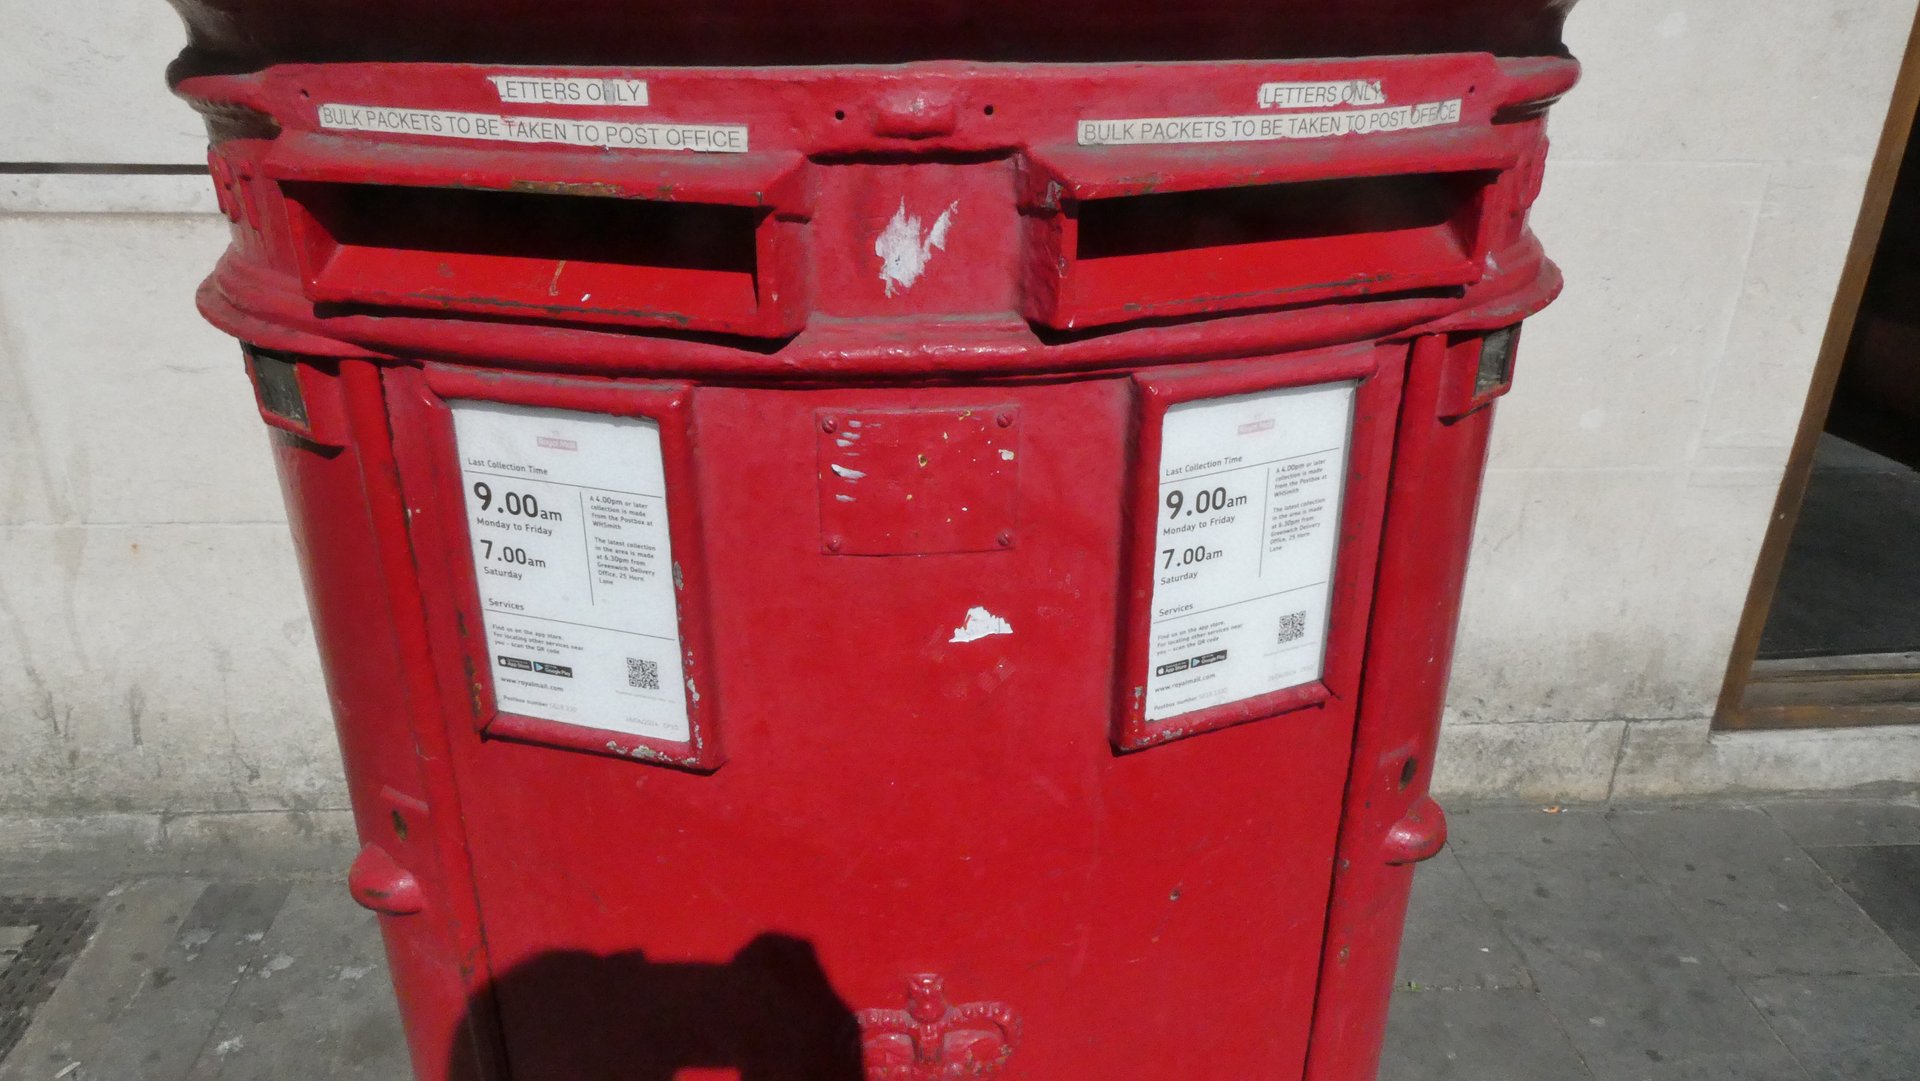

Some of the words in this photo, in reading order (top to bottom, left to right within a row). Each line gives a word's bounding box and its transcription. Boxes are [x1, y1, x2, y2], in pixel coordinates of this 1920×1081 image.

[1263, 86, 1337, 105] LETTERS
[322, 107, 362, 126] BULK
[366, 110, 442, 132] PACKETS
[446, 116, 471, 134] TO
[477, 119, 500, 136] BE
[504, 120, 567, 140] TAKEN
[572, 124, 600, 142] TO
[606, 126, 659, 145] POST
[666, 129, 740, 148] OFFICE
[1084, 123, 1136, 142] BULK
[1141, 121, 1226, 140] PACKETS
[1232, 120, 1255, 137] TO
[1260, 119, 1283, 136] BE
[1289, 116, 1341, 135] TAKEN
[1346, 114, 1366, 131] TO
[1370, 111, 1407, 129] POST
[467, 457, 485, 467] Last
[487, 459, 526, 472] Collection
[529, 465, 548, 475] Time
[1165, 466, 1182, 476] Last
[1185, 459, 1222, 473] Collection
[1223, 455, 1243, 465] Time
[473, 481, 562, 521] 9.00am
[1166, 487, 1247, 520] 9.00am
[476, 517, 510, 530] Monday
[513, 522, 522, 531] to
[525, 523, 553, 536] Friday
[1162, 523, 1196, 536] Monday
[1199, 521, 1207, 529] to
[1210, 515, 1236, 526] Friday
[480, 539, 546, 568] 7.00am
[594, 536, 606, 544] The
[607, 538, 625, 546] latest
[626, 542, 656, 551] collection
[1162, 545, 1223, 570] 7.00am
[483, 566, 522, 580] Saturday
[1160, 571, 1198, 586] Saturday
[488, 598, 525, 611] Services
[1158, 603, 1193, 617] Services
